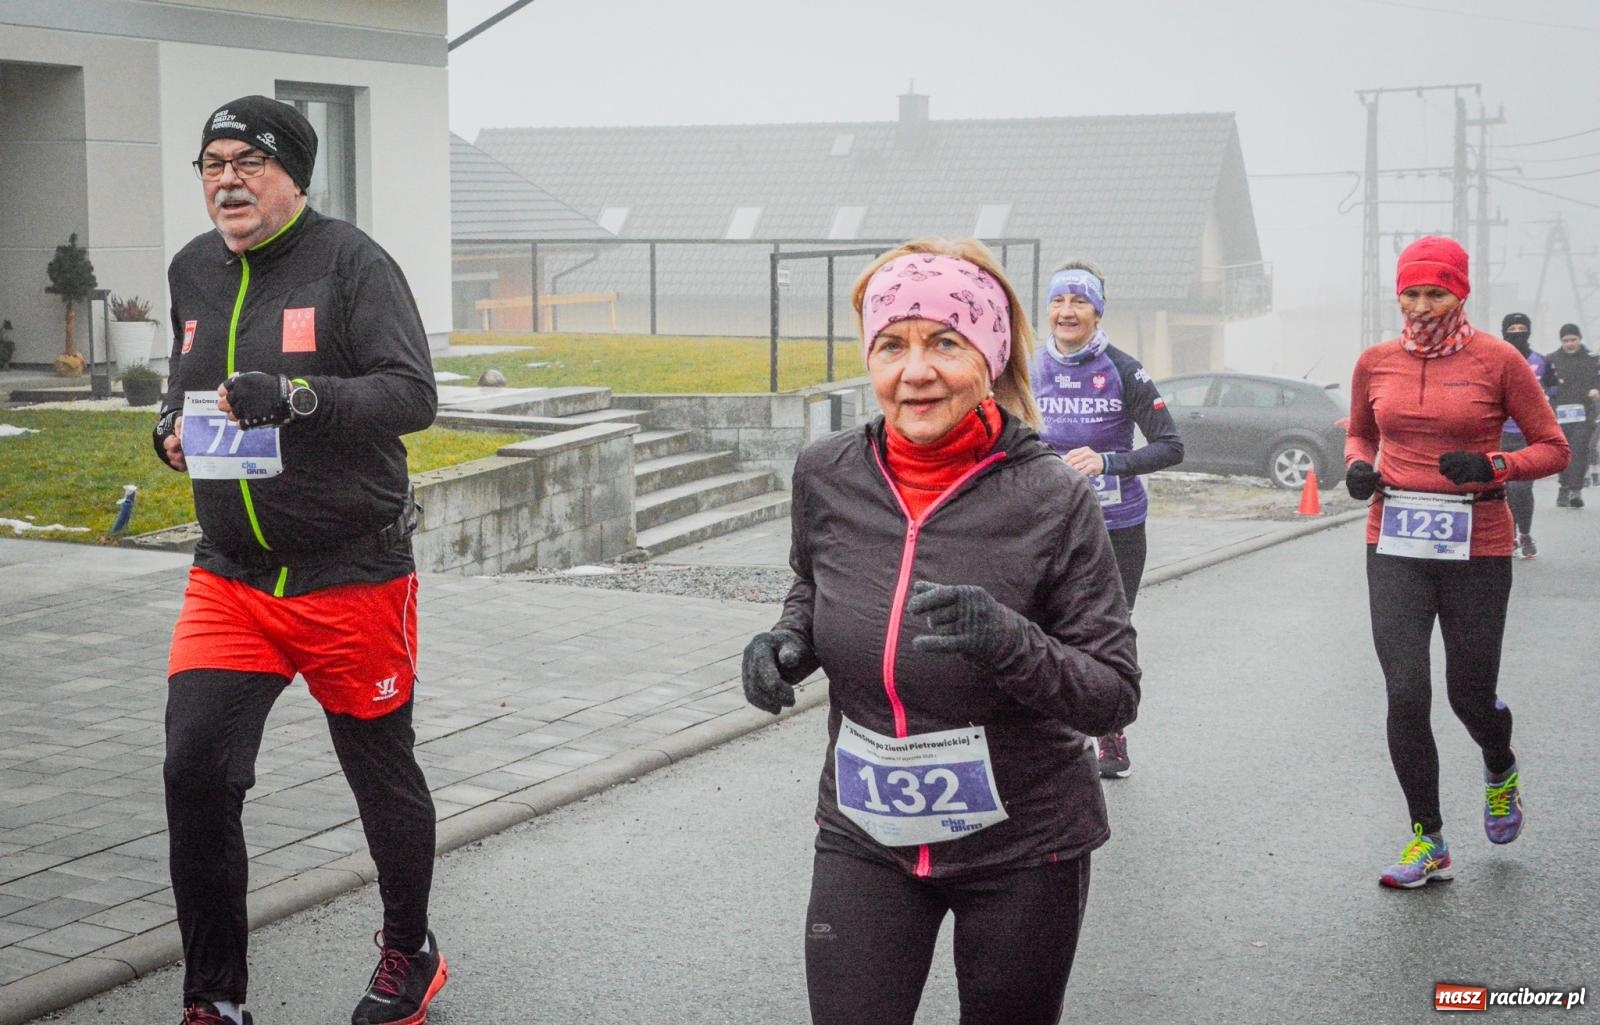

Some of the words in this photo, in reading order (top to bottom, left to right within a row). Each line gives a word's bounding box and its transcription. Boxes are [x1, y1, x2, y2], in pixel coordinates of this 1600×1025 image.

[1036, 397, 1122, 414] UNNERS
[1396, 510, 1454, 540] 123
[910, 736, 970, 751] Pietrowickiej
[858, 764, 969, 814] 132
